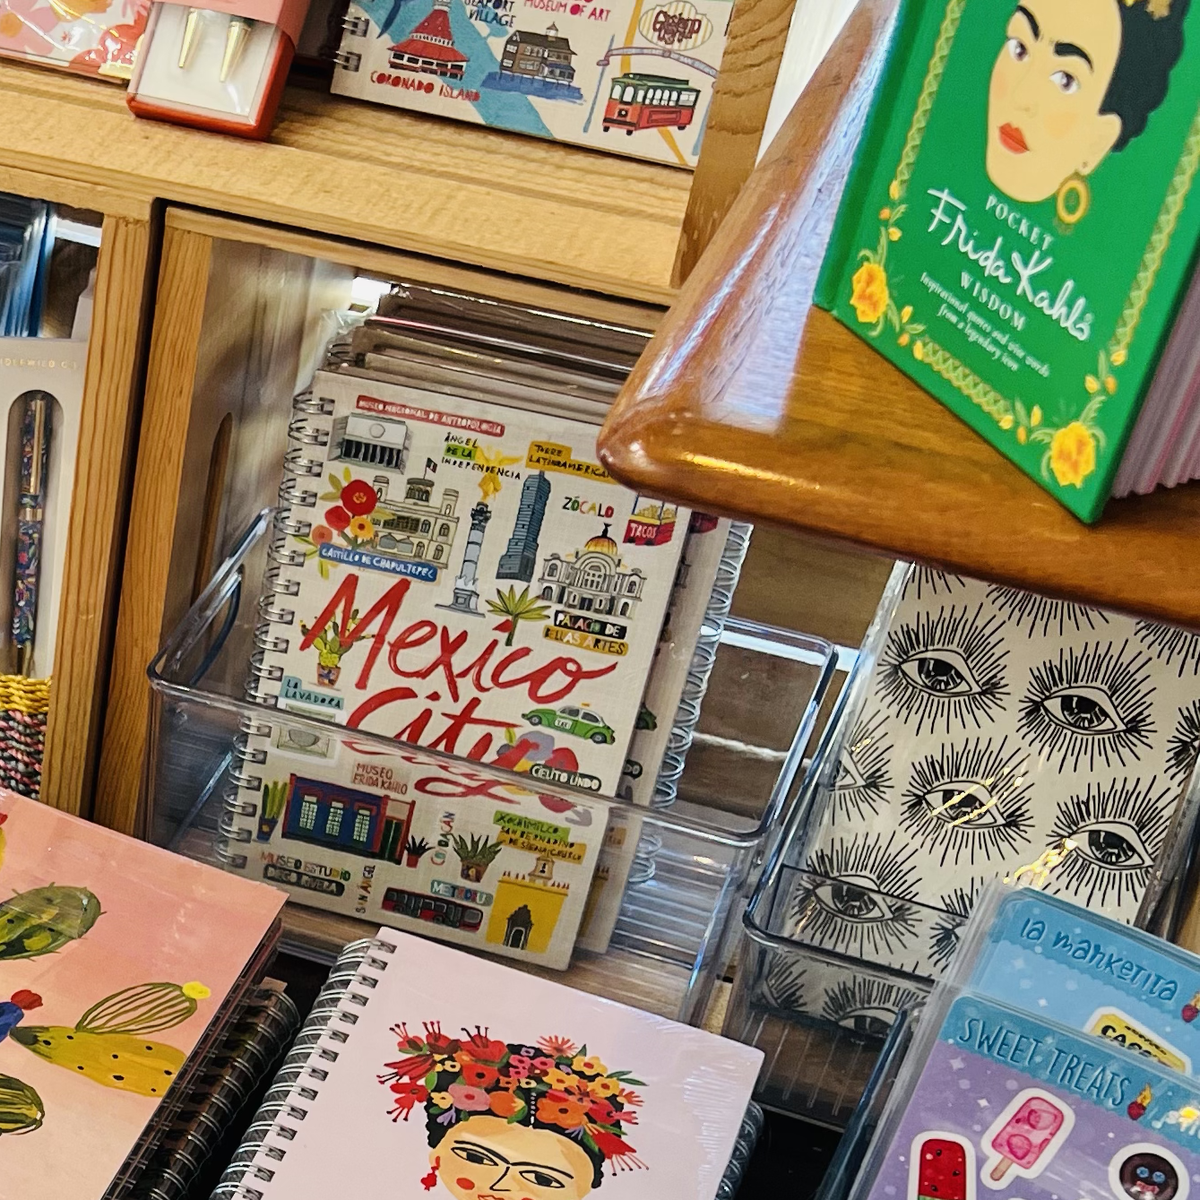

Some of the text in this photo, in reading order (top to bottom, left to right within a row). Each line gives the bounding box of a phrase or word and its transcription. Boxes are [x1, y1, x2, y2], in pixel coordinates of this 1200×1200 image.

[468, 10, 517, 28] VILLAGE
[570, 4, 585, 16] OF
[588, 8, 611, 22] ART
[370, 71, 481, 102] CORONADO ISLAND
[985, 194, 1054, 251] POCKET
[927, 188, 1092, 341] Frida Kahlo
[961, 271, 1026, 331] WISDOM
[428, 412, 440, 422] DE
[446, 447, 473, 458] DE LA
[534, 444, 563, 457] TORRE
[441, 456, 521, 480] INDEPENDENCIA
[629, 523, 657, 539] TACOS
[361, 554, 372, 565] DE
[372, 557, 434, 579] CHAPULTEPEC
[556, 612, 621, 637] PALACIO DE
[300, 573, 618, 704] Mexico
[583, 637, 626, 655] ARTES
[286, 678, 299, 689] LA
[284, 690, 341, 709] LAVADORA
[356, 763, 394, 779] MUSEO
[352, 773, 408, 796] FRIDA KAHLO
[500, 826, 518, 836] SAN
[260, 851, 303, 870] MUSEO
[959, 1018, 1043, 1066] SWEET
[1047, 1048, 1132, 1107] TREATS
